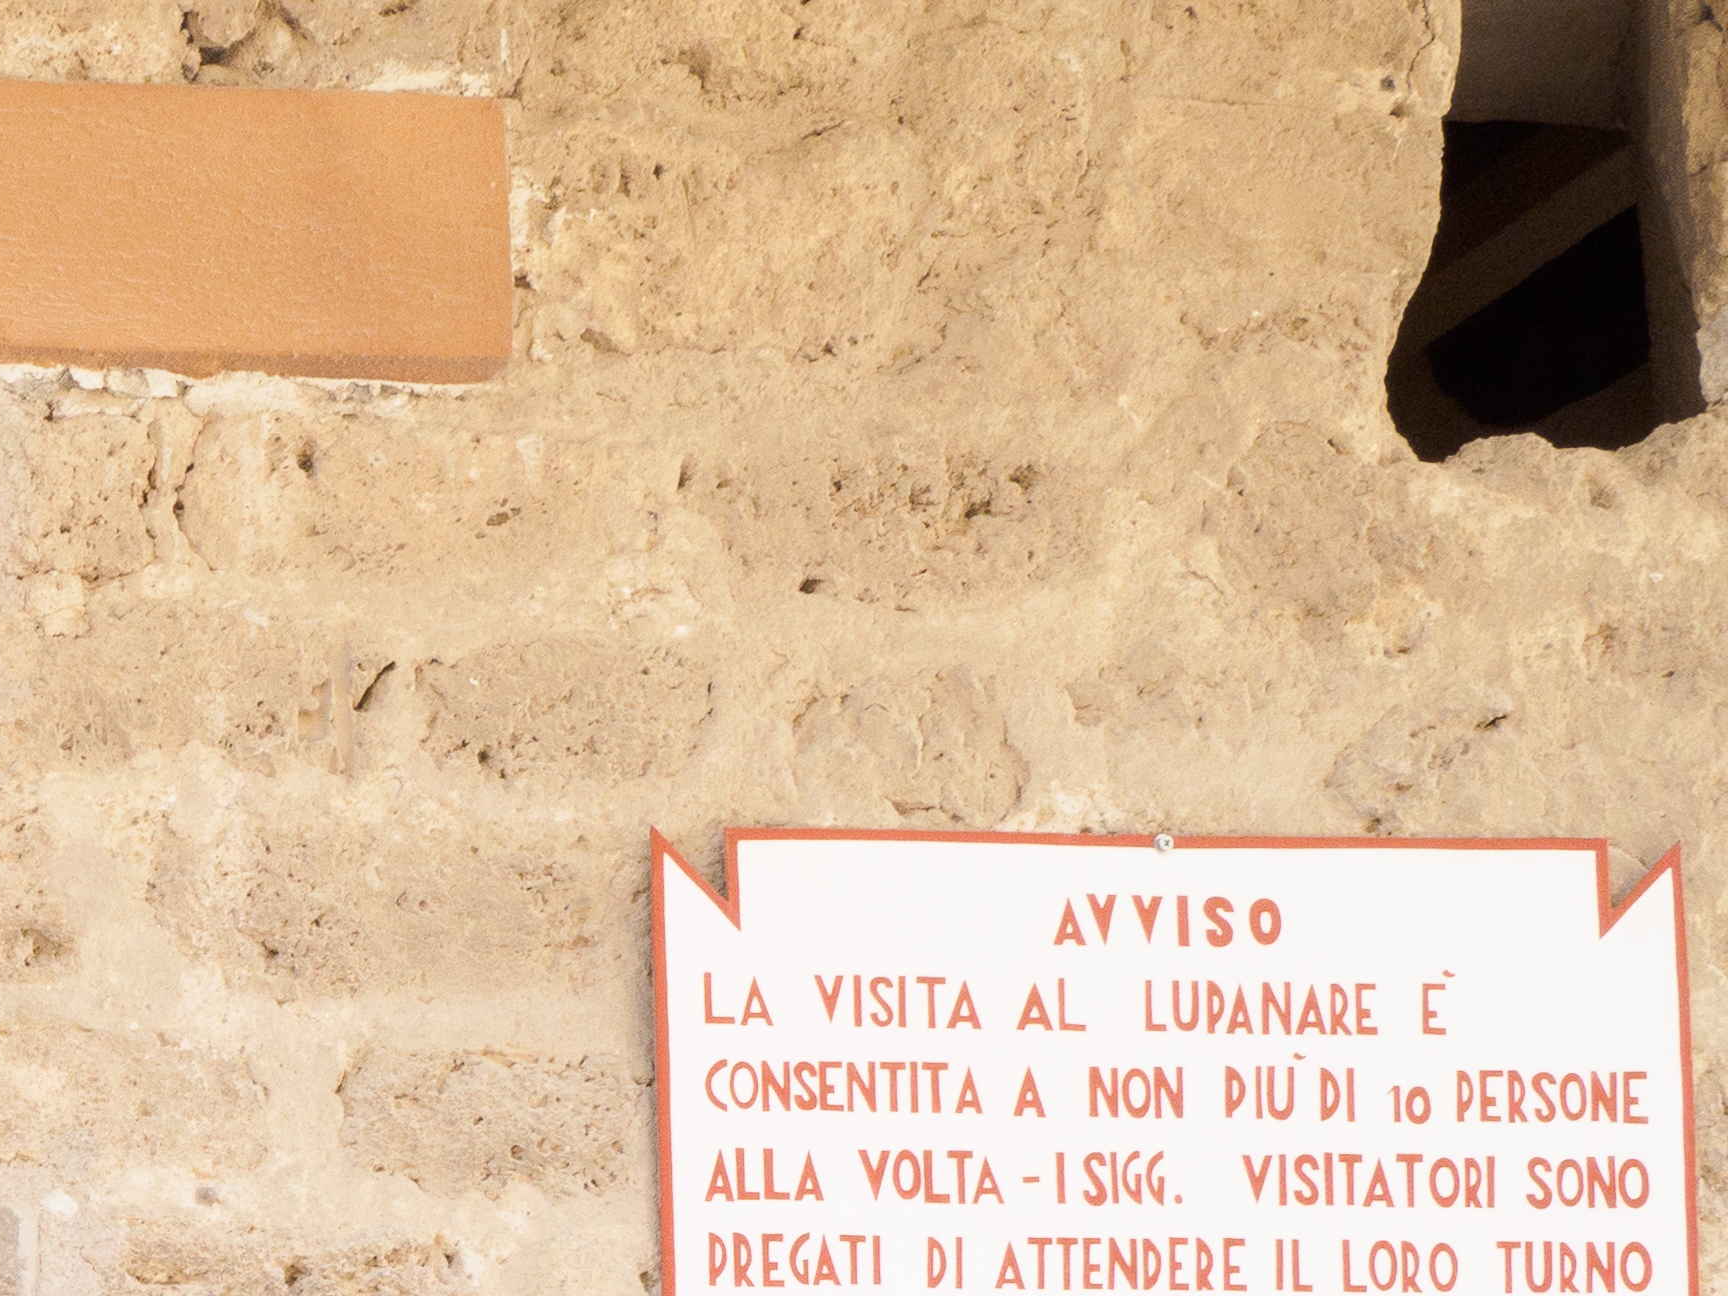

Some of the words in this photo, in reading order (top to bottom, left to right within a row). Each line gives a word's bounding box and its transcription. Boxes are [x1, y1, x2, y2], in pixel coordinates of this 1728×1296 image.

[1053, 893, 1283, 948] AVVISO
[703, 971, 773, 1027] LA
[815, 974, 982, 1030] VISITA
[1016, 977, 1087, 1032] AL
[1145, 979, 1379, 1036] LUPANARE
[704, 1058, 983, 1114] CONSENTITA
[1013, 1067, 1046, 1118] A
[1088, 1066, 1184, 1119] NON
[1319, 1067, 1356, 1123] DI
[1387, 1084, 1432, 1125] 10
[1456, 1069, 1649, 1125] PERSONE
[705, 1147, 825, 1202] ALLA
[858, 1149, 1005, 1205] VOLTA
[1083, 1150, 1183, 1207] SIGG.
[1242, 1151, 1496, 1209] VISITATORI
[1526, 1155, 1651, 1210] SONO
[708, 1231, 882, 1288] PREGATI
[927, 1236, 963, 1289] DI
[995, 1236, 1248, 1292] ATTENDERE
[1275, 1239, 1313, 1293] IL
[1341, 1239, 1459, 1293] LORO
[1496, 1240, 1653, 1294] TURNO
